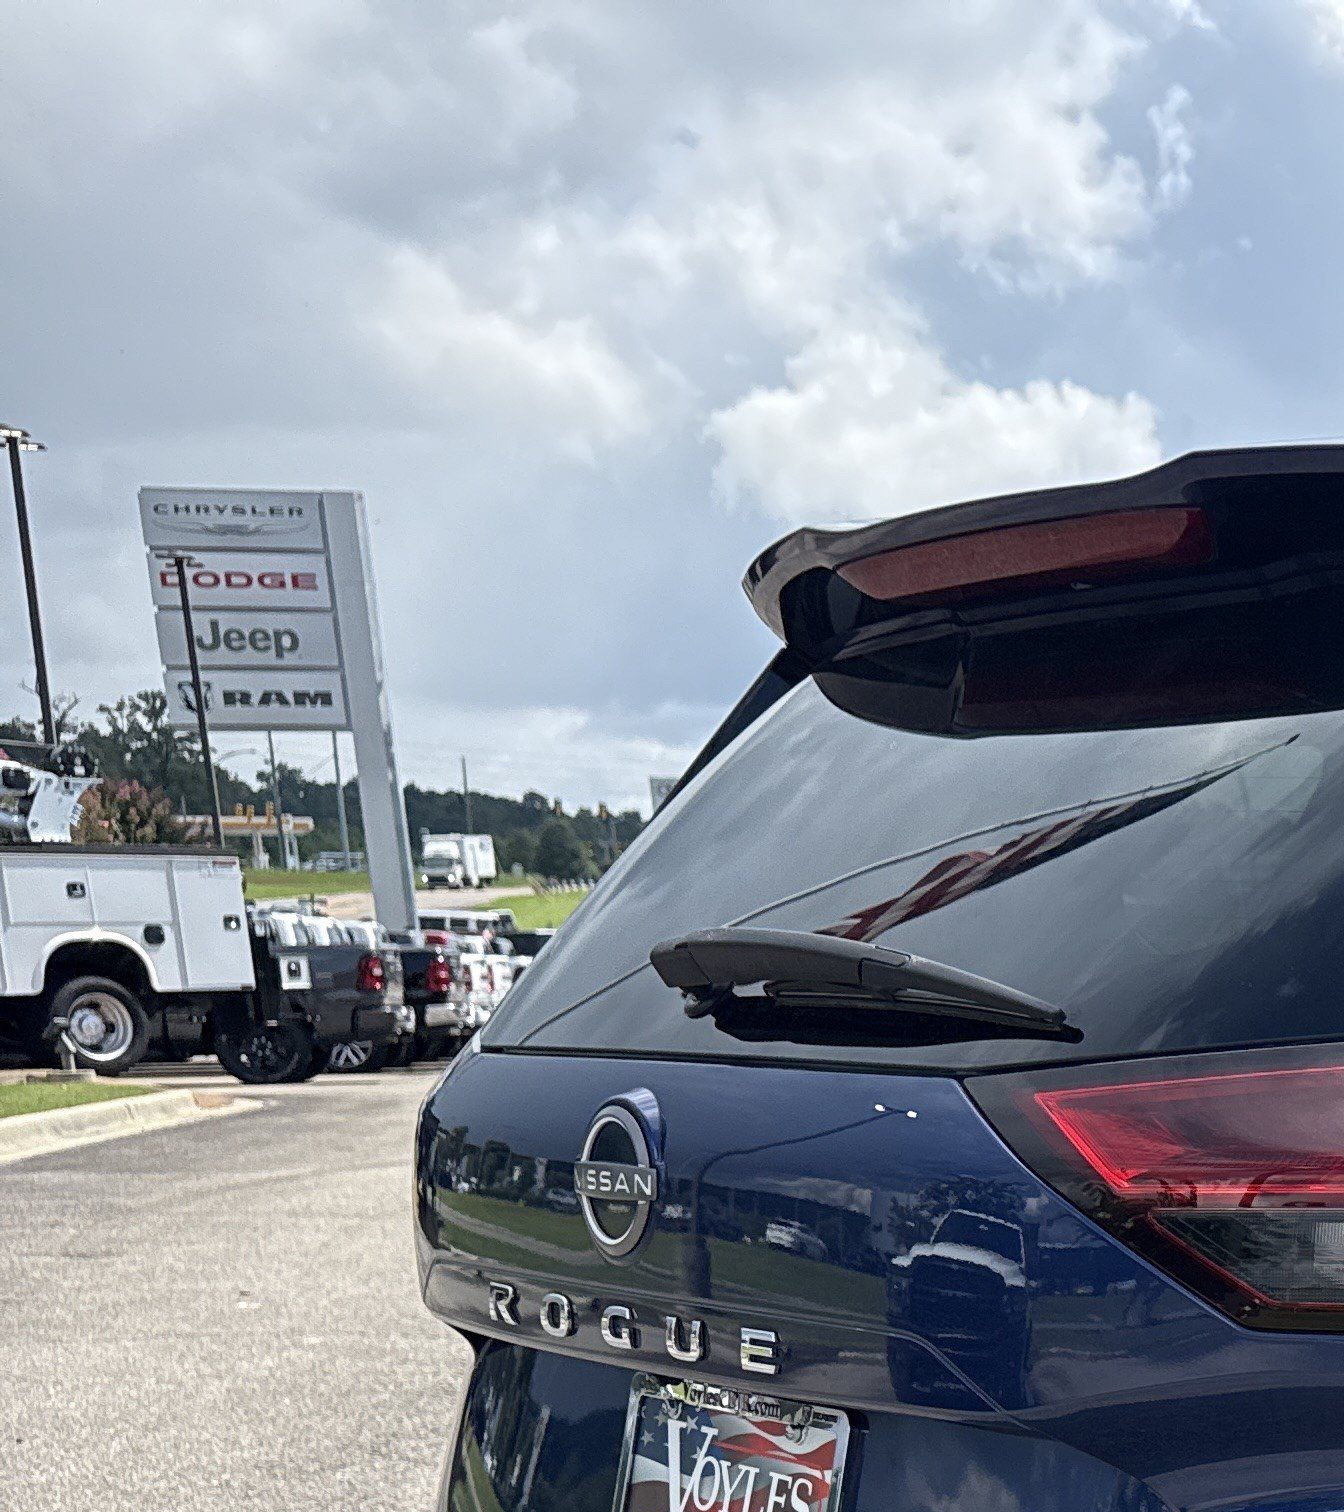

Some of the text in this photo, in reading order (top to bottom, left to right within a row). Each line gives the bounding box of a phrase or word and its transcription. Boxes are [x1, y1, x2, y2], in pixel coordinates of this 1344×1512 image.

[152, 502, 304, 518] CHRYSLER
[159, 569, 319, 591] DODGE
[195, 618, 301, 659] Jeep
[222, 689, 333, 708] RAM
[488, 1280, 779, 1377] ROGUE
